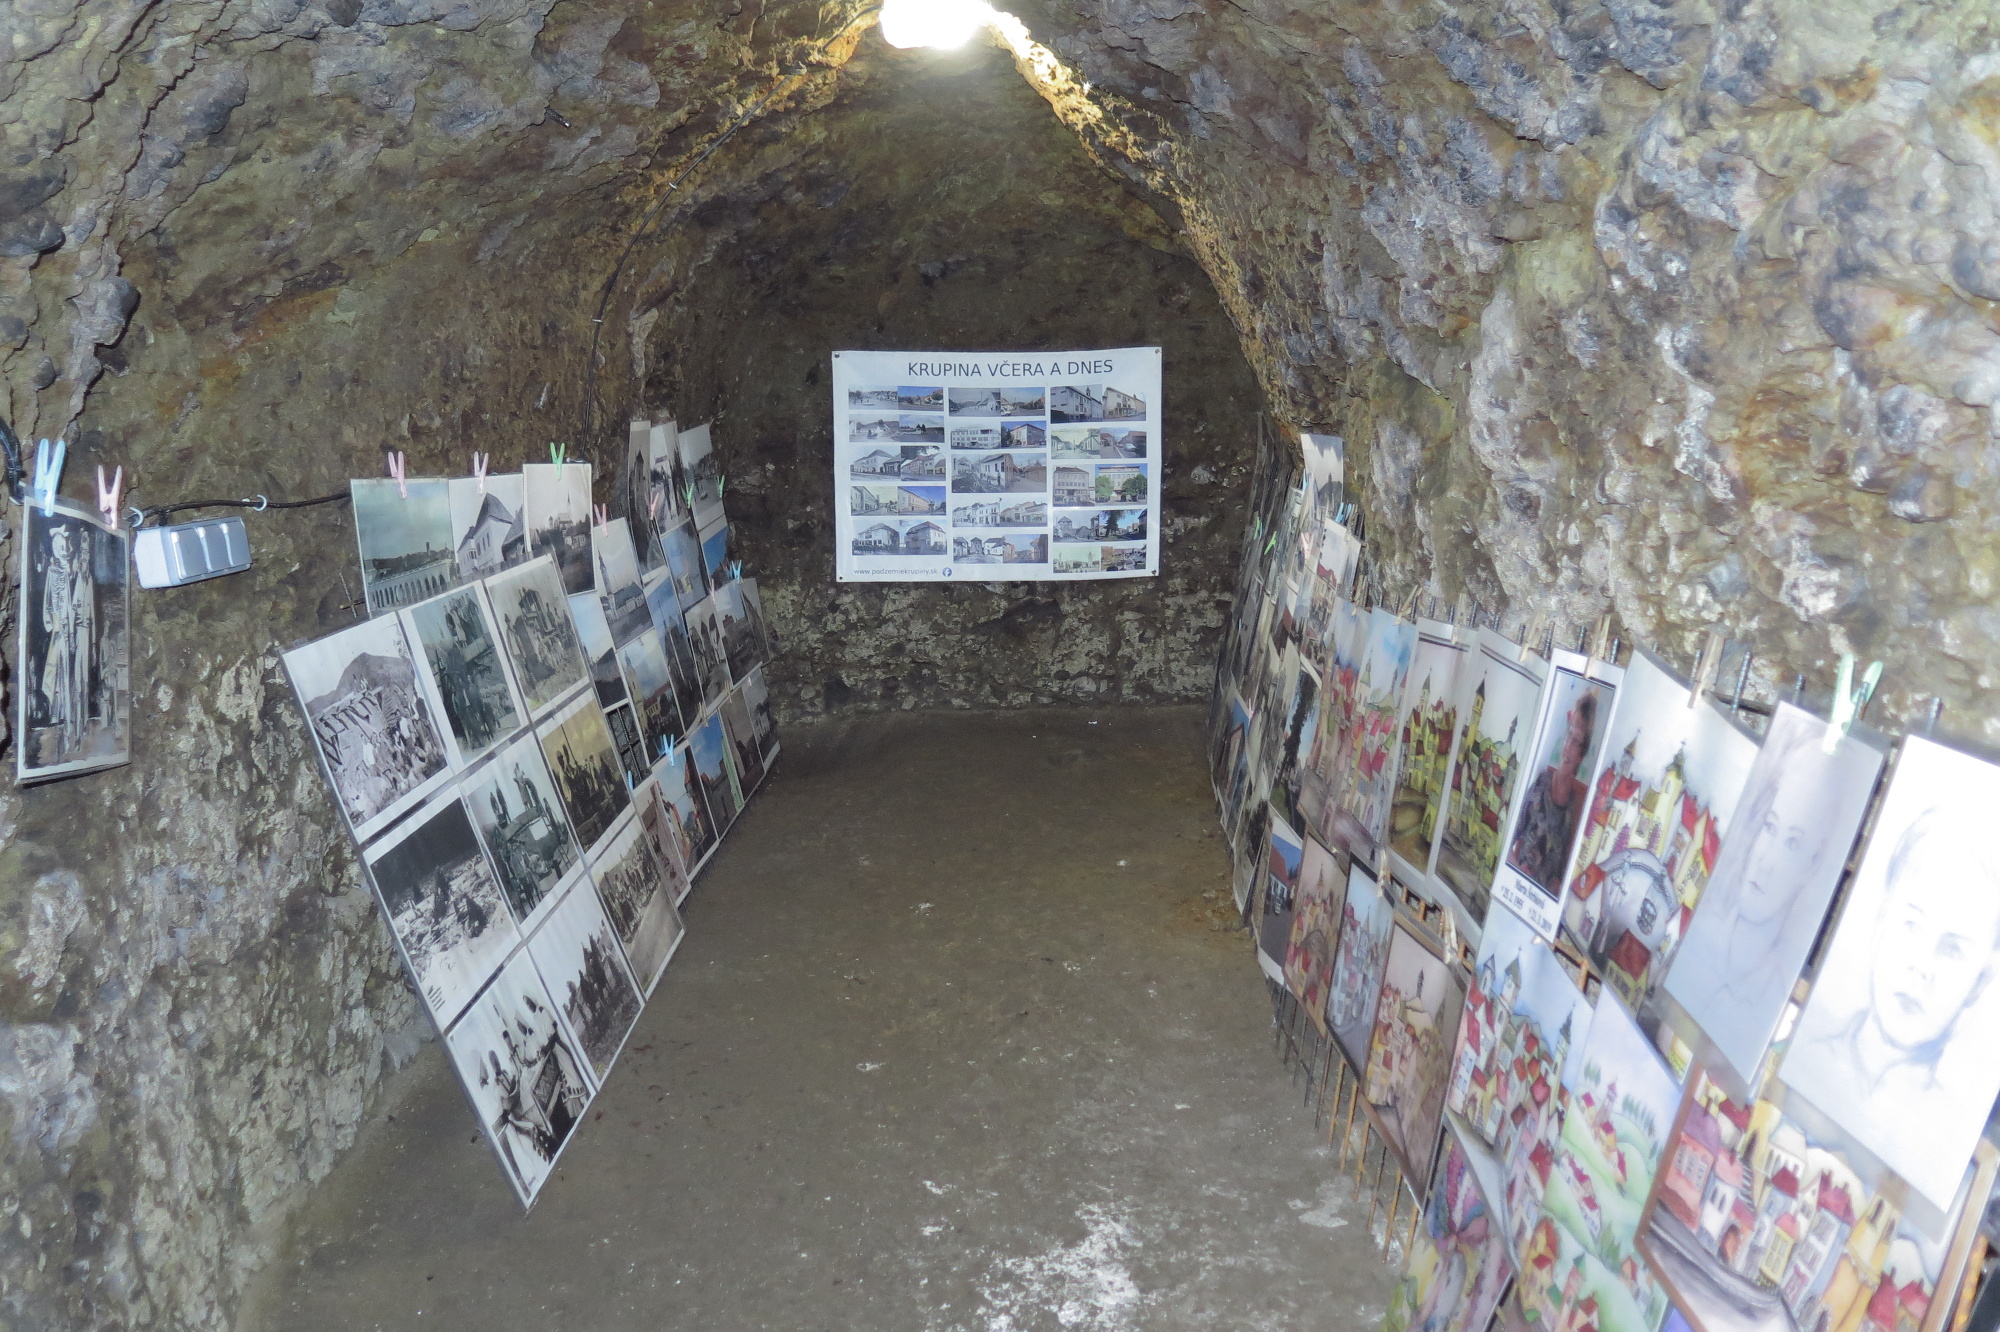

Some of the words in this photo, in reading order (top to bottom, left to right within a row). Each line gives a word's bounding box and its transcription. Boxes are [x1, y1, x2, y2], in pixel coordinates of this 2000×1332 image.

[908, 362, 982, 377] KRUPINA
[987, 360, 1045, 377] VČERA
[1050, 362, 1062, 376] A
[1067, 360, 1114, 375] DNES
